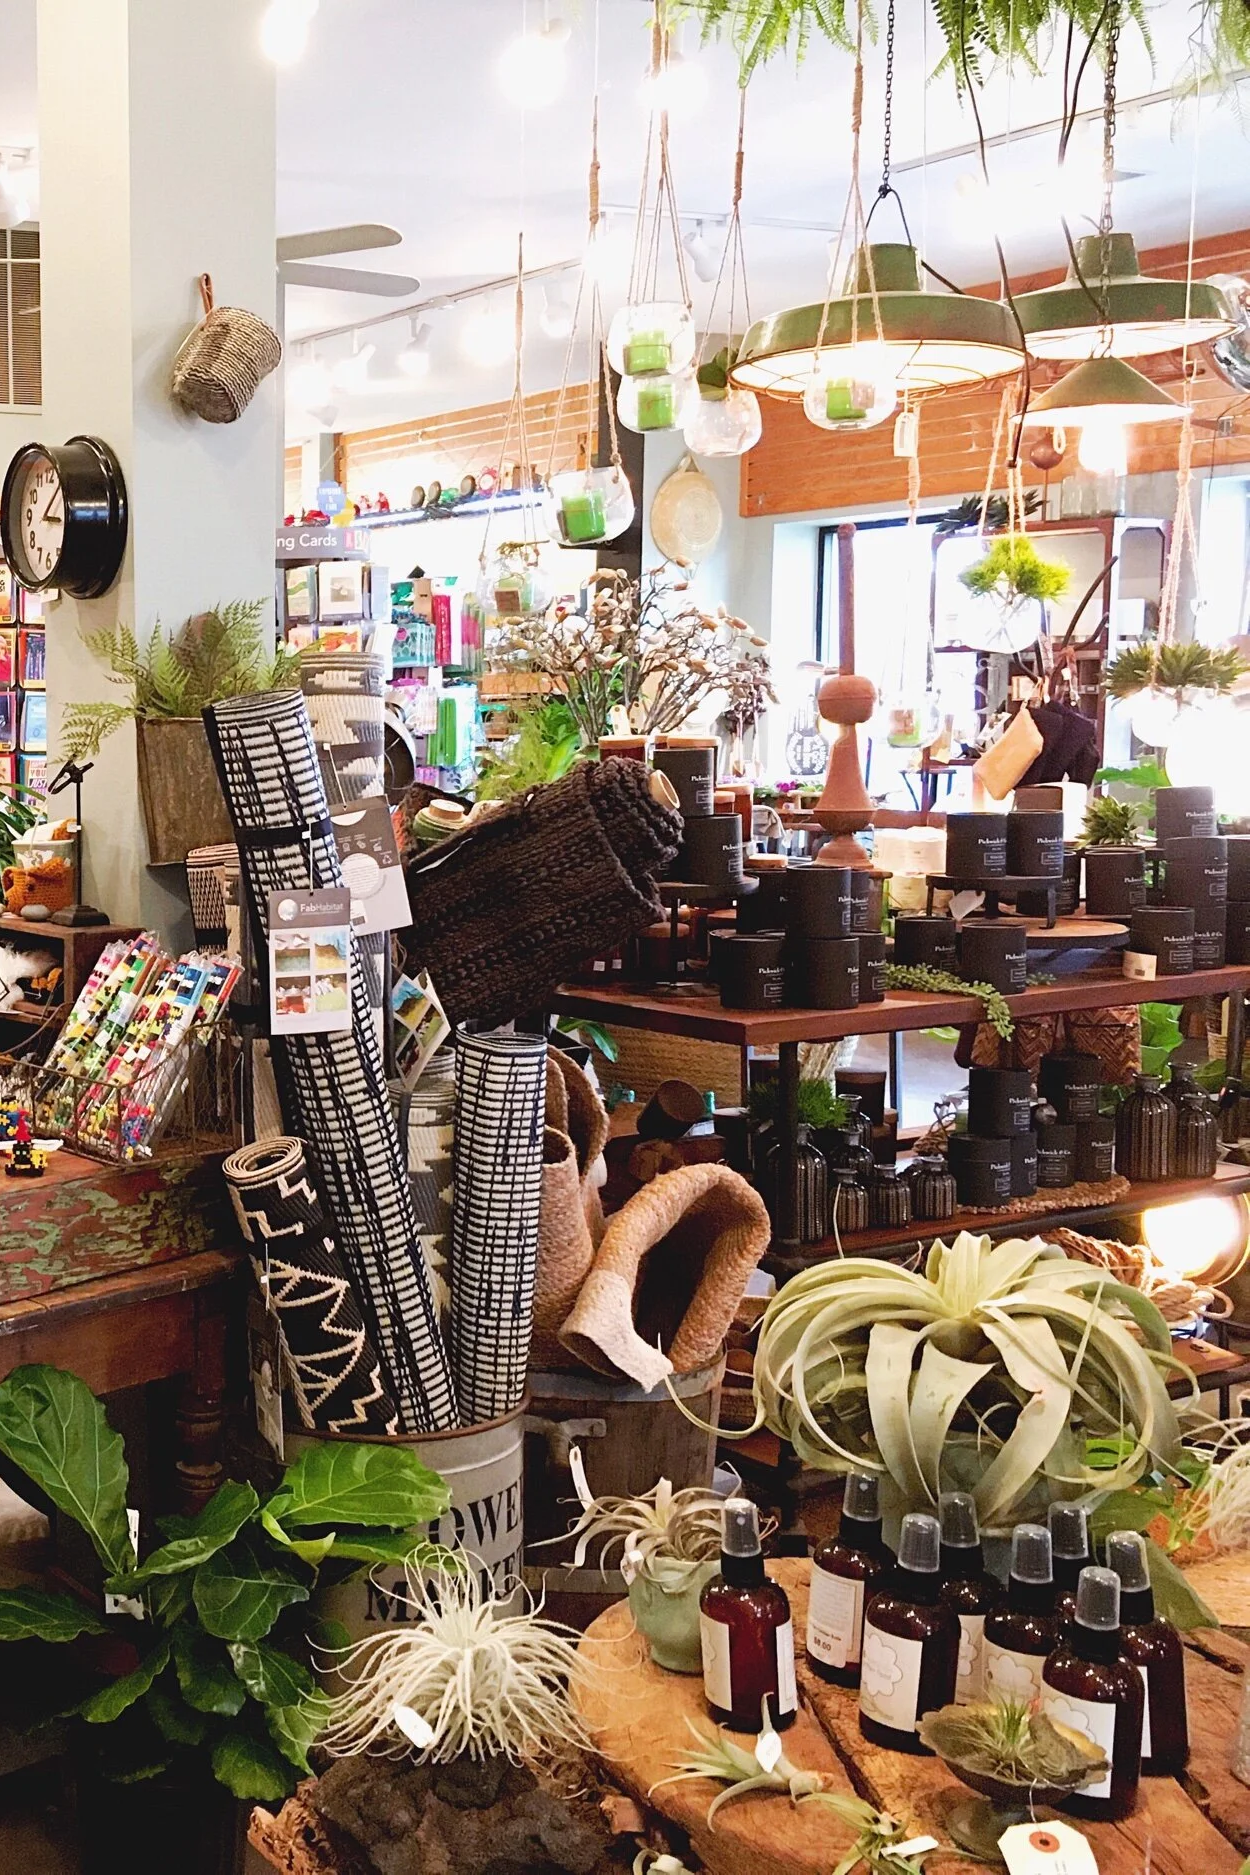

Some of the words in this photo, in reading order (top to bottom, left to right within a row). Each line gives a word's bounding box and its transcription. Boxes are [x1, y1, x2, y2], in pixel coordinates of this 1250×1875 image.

[36, 474, 43, 487] 11
[45, 469, 54, 484] 12
[29, 489, 38, 505] 10
[26, 509, 32, 526] 9
[30, 531, 36, 549] 8
[299, 533, 338, 547] Cards
[37, 547, 43, 564] 7
[45, 552, 52, 570] 6
[30, 769, 46, 777] YOU
[300, 903, 344, 912] FabHabitat
[429, 1476, 522, 1550] OWE
